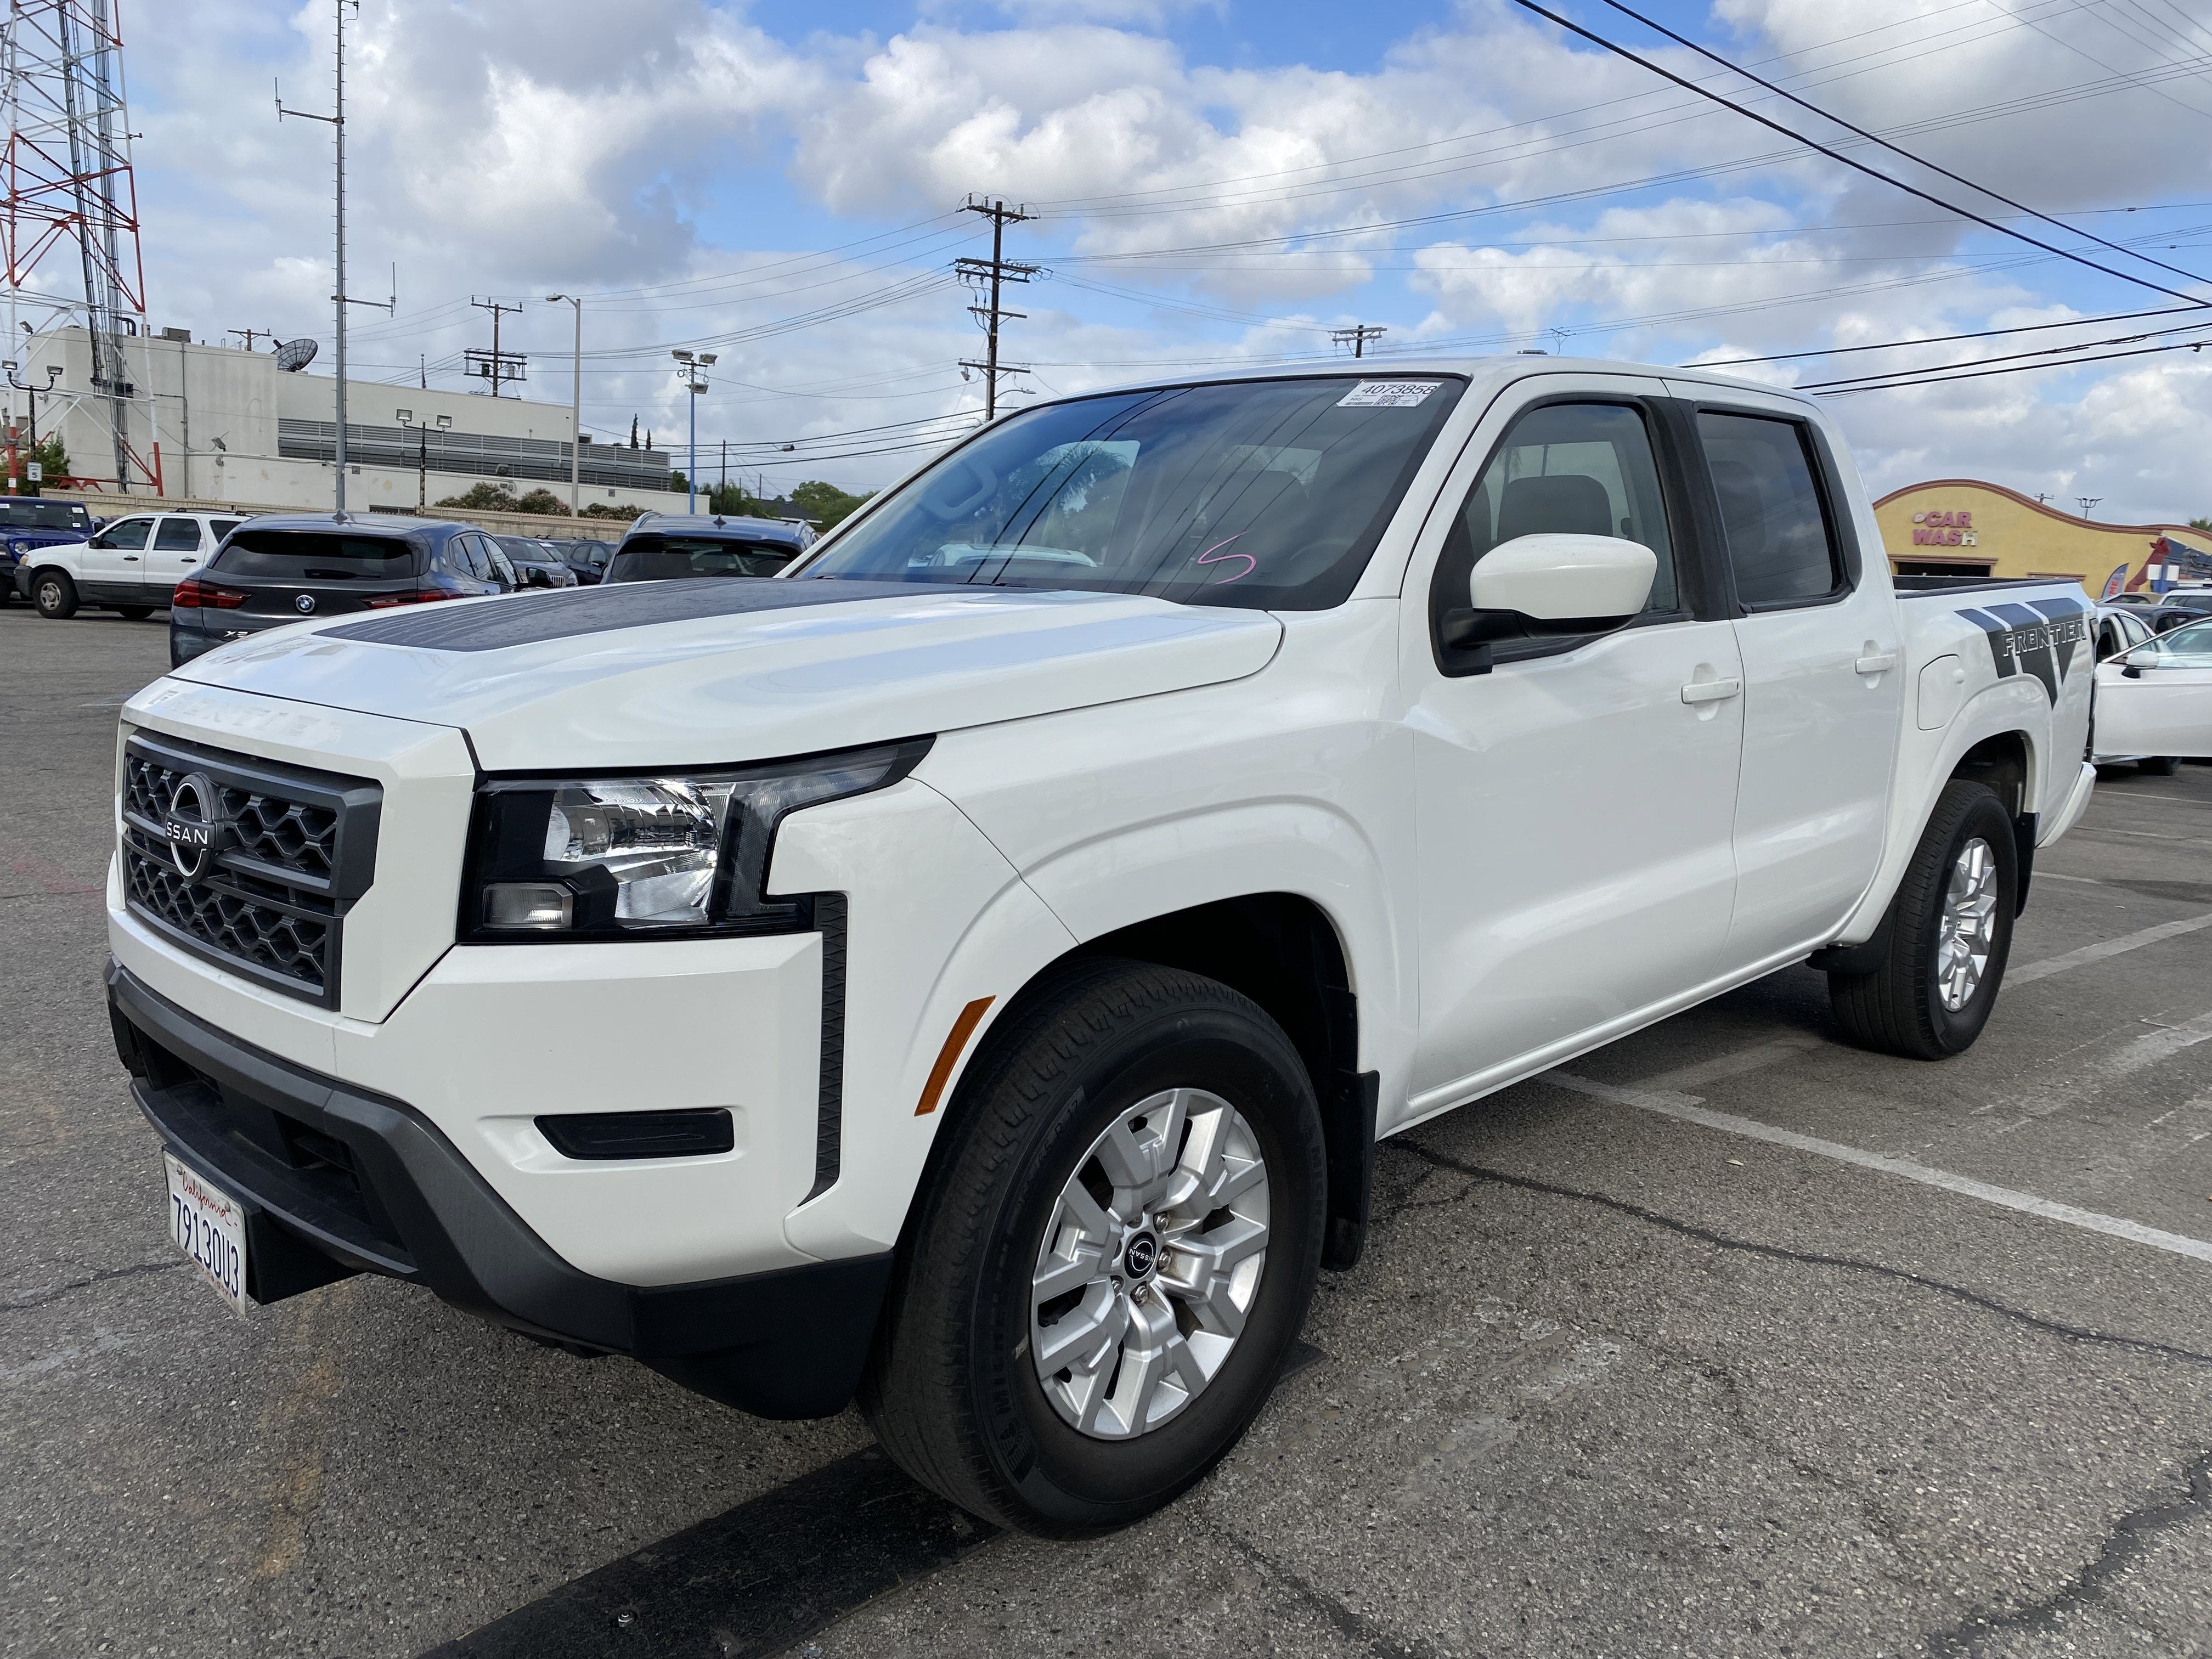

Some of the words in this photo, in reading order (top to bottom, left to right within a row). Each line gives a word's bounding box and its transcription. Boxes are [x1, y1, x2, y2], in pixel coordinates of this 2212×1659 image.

[1361, 385, 1438, 395] 4073858
[1925, 511, 1972, 528] CAR
[1912, 529, 1978, 546] WASH
[2002, 618, 2087, 657] FRONTIER
[167, 821, 208, 844] SSAN
[183, 1171, 232, 1227] California
[172, 1194, 239, 1298] 79130U3
[1129, 1248, 1154, 1263] NISSAN
